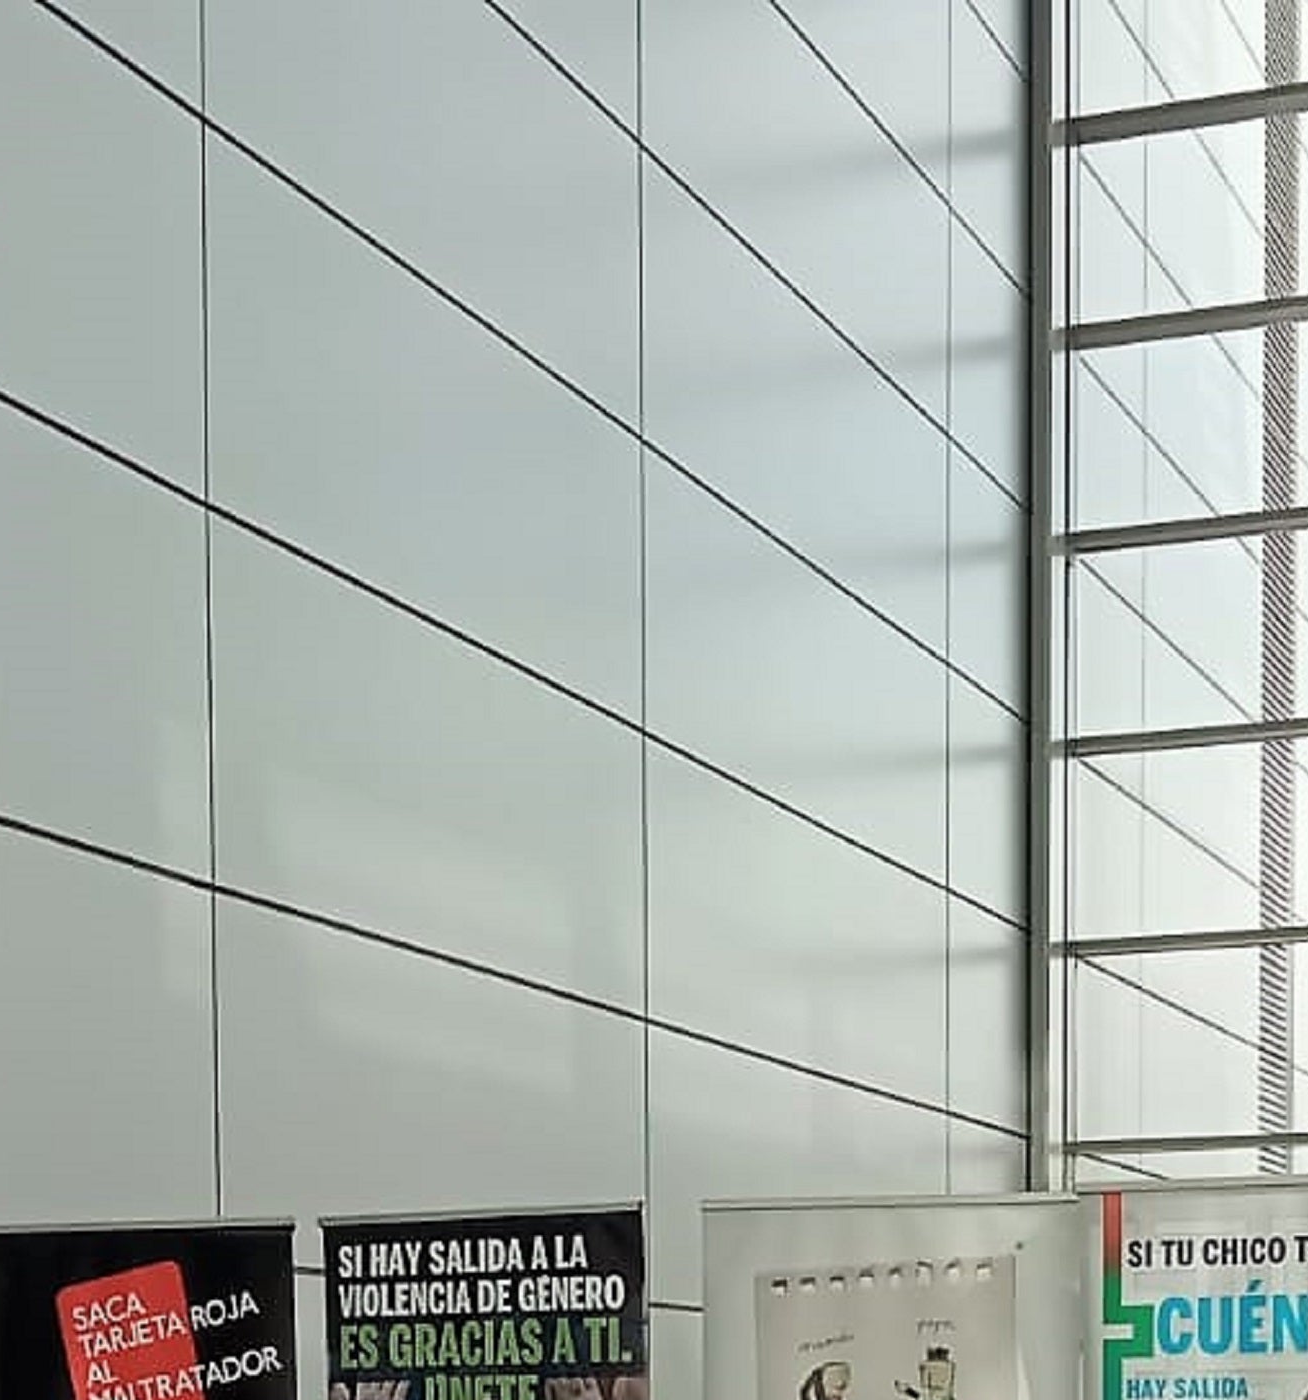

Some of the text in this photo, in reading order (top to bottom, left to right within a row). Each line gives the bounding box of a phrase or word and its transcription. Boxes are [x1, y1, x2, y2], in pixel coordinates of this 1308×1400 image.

[339, 1235, 589, 1279] SI HAY SALIDA A LA
[1127, 1240, 1153, 1268] SI
[1161, 1239, 1193, 1267] TU
[1202, 1236, 1287, 1266] CHICO
[72, 1292, 146, 1332] SACA
[339, 1280, 472, 1318] VIOLENCIA
[477, 1279, 512, 1314] DE
[77, 1290, 260, 1358] TARJETA ROJA
[340, 1316, 634, 1369] ES GRACIAS A TI.
[87, 1361, 120, 1389] AL
[1126, 1377, 1248, 1400] HAY SALIDA
